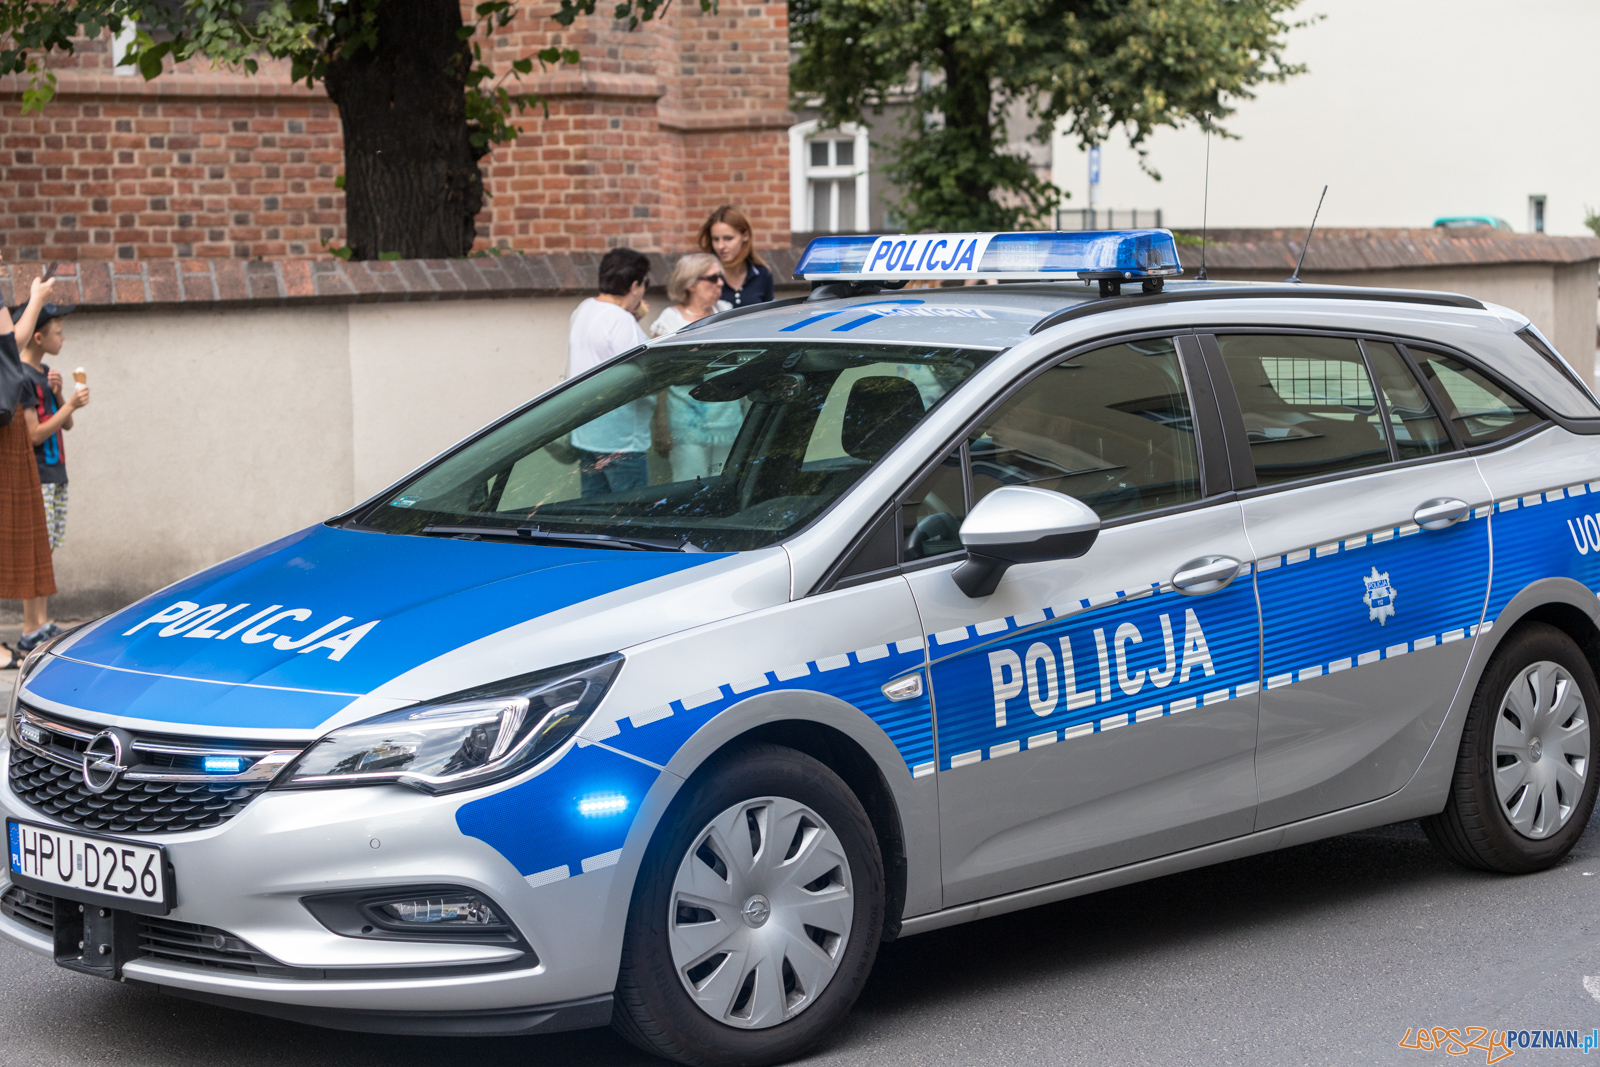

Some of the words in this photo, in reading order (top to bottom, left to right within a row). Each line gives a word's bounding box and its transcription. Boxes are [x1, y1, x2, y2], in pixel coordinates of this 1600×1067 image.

[868, 238, 979, 272] POLICJA
[1566, 513, 1600, 555] UO
[1367, 578, 1389, 591] POLICJA
[121, 600, 381, 662] POLICJA
[987, 607, 1216, 729] POLICJA
[12, 853, 21, 866] PL
[22, 828, 74, 882] HPU
[84, 842, 157, 898] D256
[865, 903, 879, 949] 205/55
[852, 976, 861, 987] V
